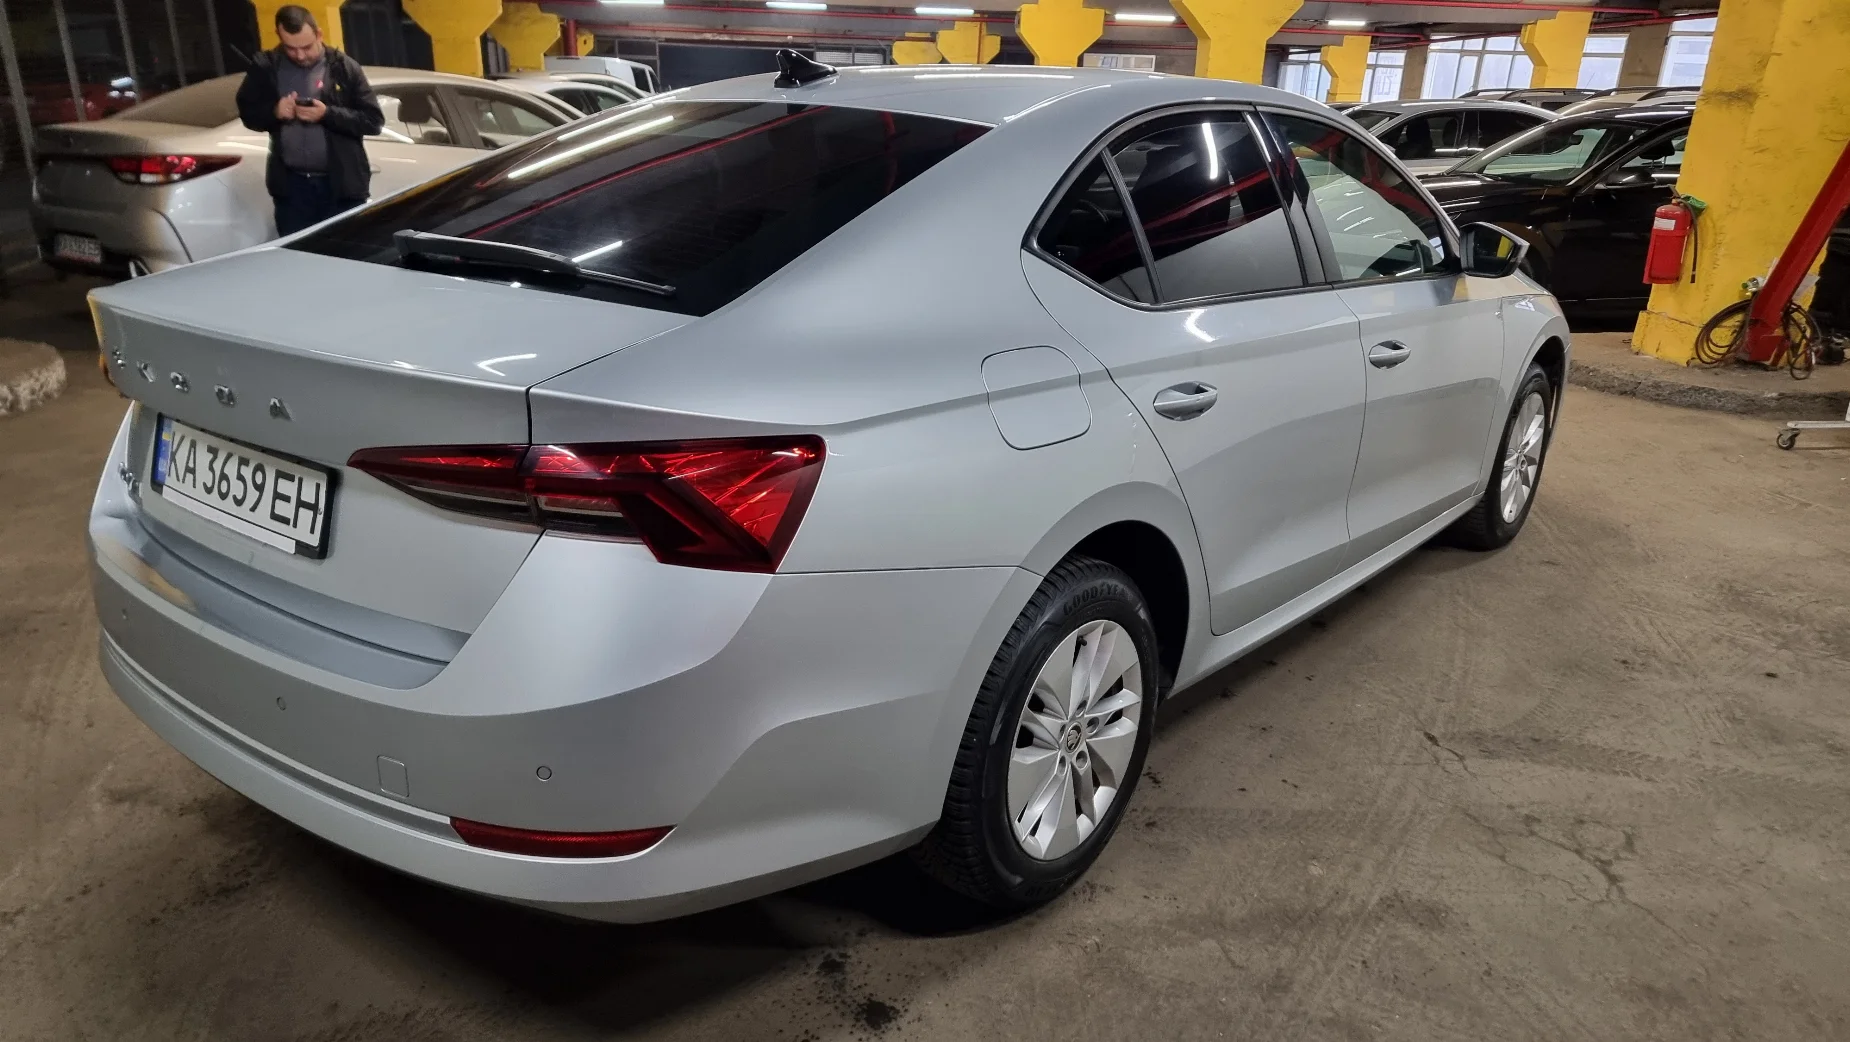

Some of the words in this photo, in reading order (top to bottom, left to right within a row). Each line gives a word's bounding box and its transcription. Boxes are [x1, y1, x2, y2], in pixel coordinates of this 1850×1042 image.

[168, 431, 197, 489] KA
[202, 444, 267, 513] 3659
[270, 468, 321, 535] EH
